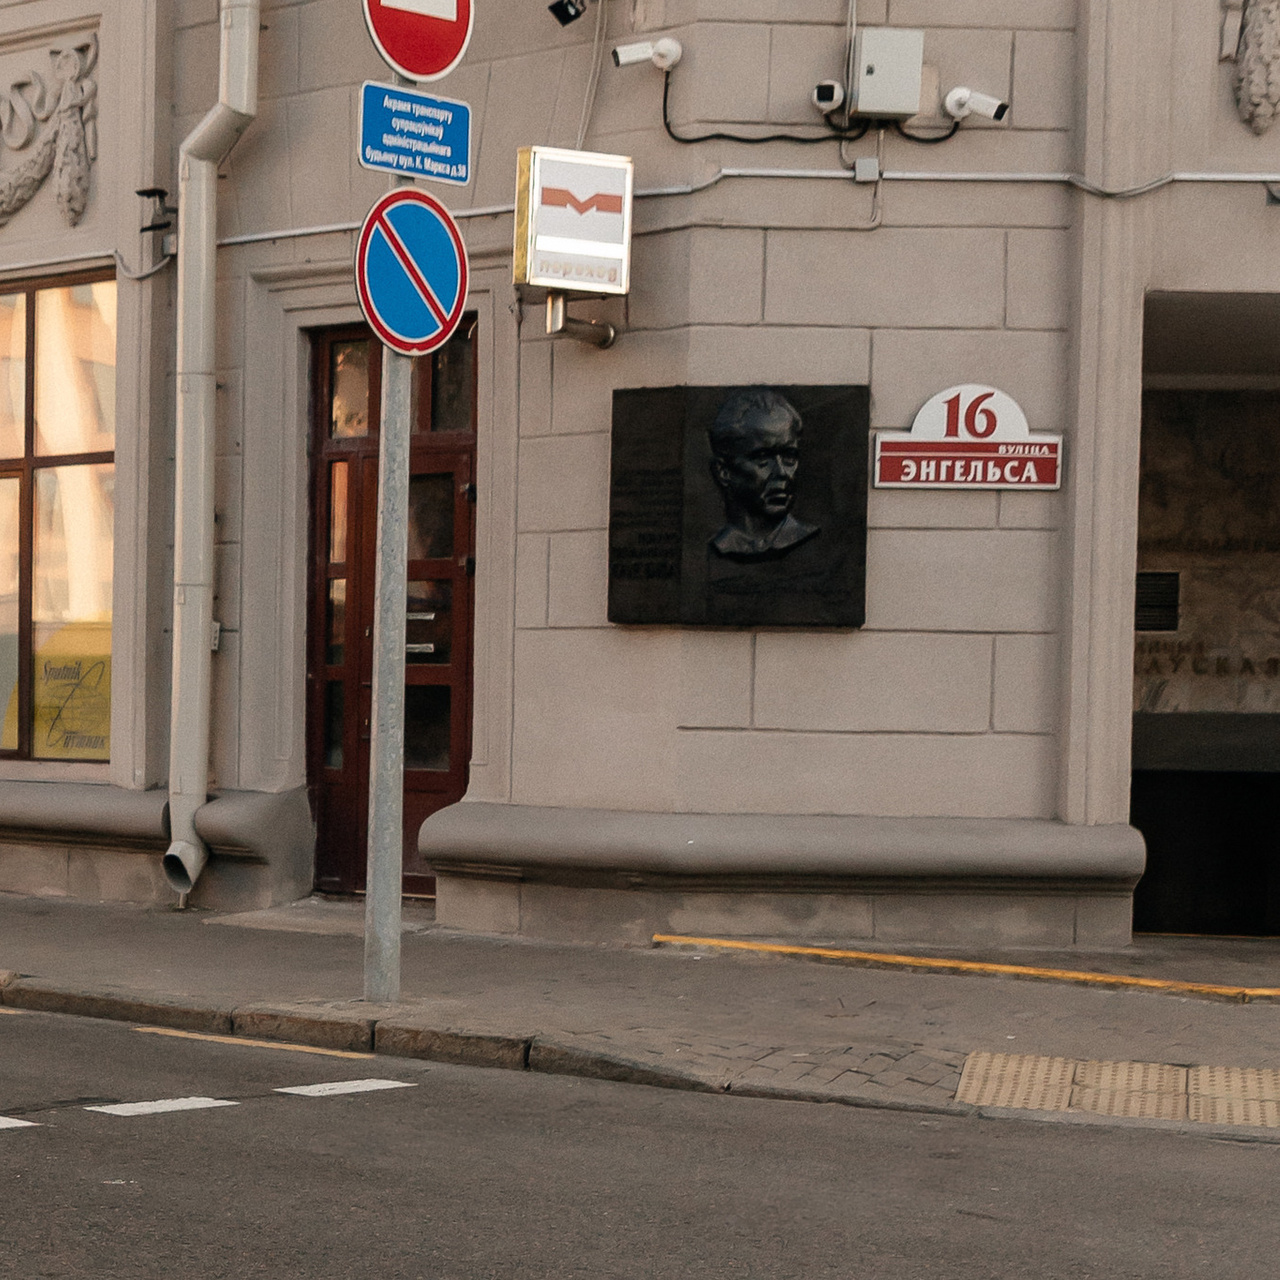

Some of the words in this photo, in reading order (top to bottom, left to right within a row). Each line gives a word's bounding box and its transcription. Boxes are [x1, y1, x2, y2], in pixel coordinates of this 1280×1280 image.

[412, 103, 453, 125] транспарту
[415, 155, 423, 169] К.
[424, 157, 450, 175] Маркса
[942, 391, 997, 439] 16
[998, 444, 1050, 456] ВУЛІЦА
[900, 459, 1038, 483] ЭНГЕЛЬСА
[41, 660, 82, 685] Sputnik
